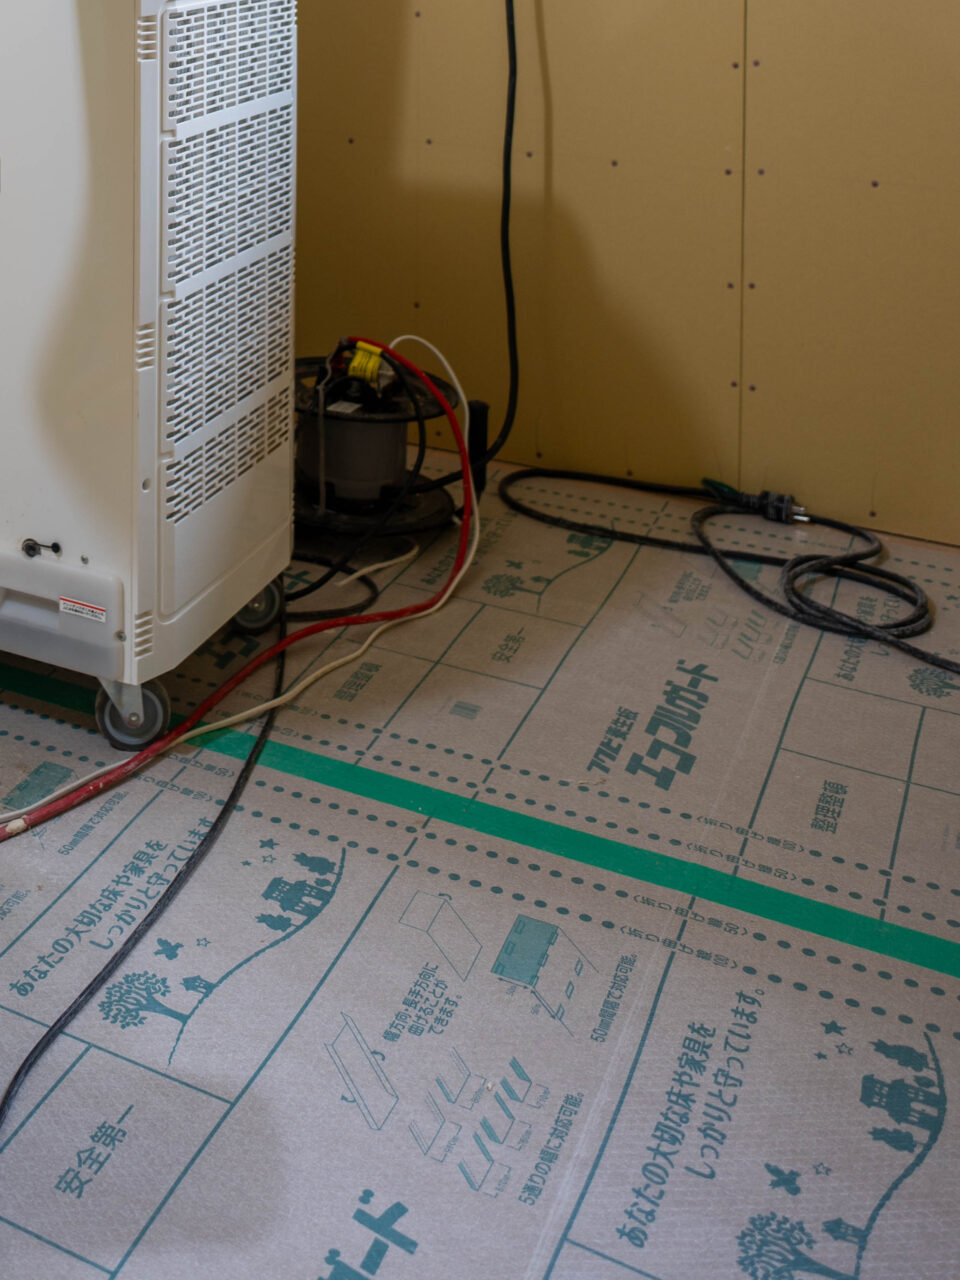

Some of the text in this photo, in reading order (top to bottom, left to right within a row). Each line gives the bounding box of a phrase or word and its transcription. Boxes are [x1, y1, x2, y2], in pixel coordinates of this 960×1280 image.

[624, 658, 719, 791] エコフルガード
[9, 838, 169, 997] あなたの大切な床や家具を
[89, 816, 214, 950] しっかりと守っています
[407, 980, 449, 1037] 曲げることが
[427, 995, 463, 1036] できます。
[615, 1021, 716, 1248] あなたの大切な床や家具を
[684, 988, 766, 1180] しっかりと守っています。
[54, 1104, 135, 1200] 安全第一
